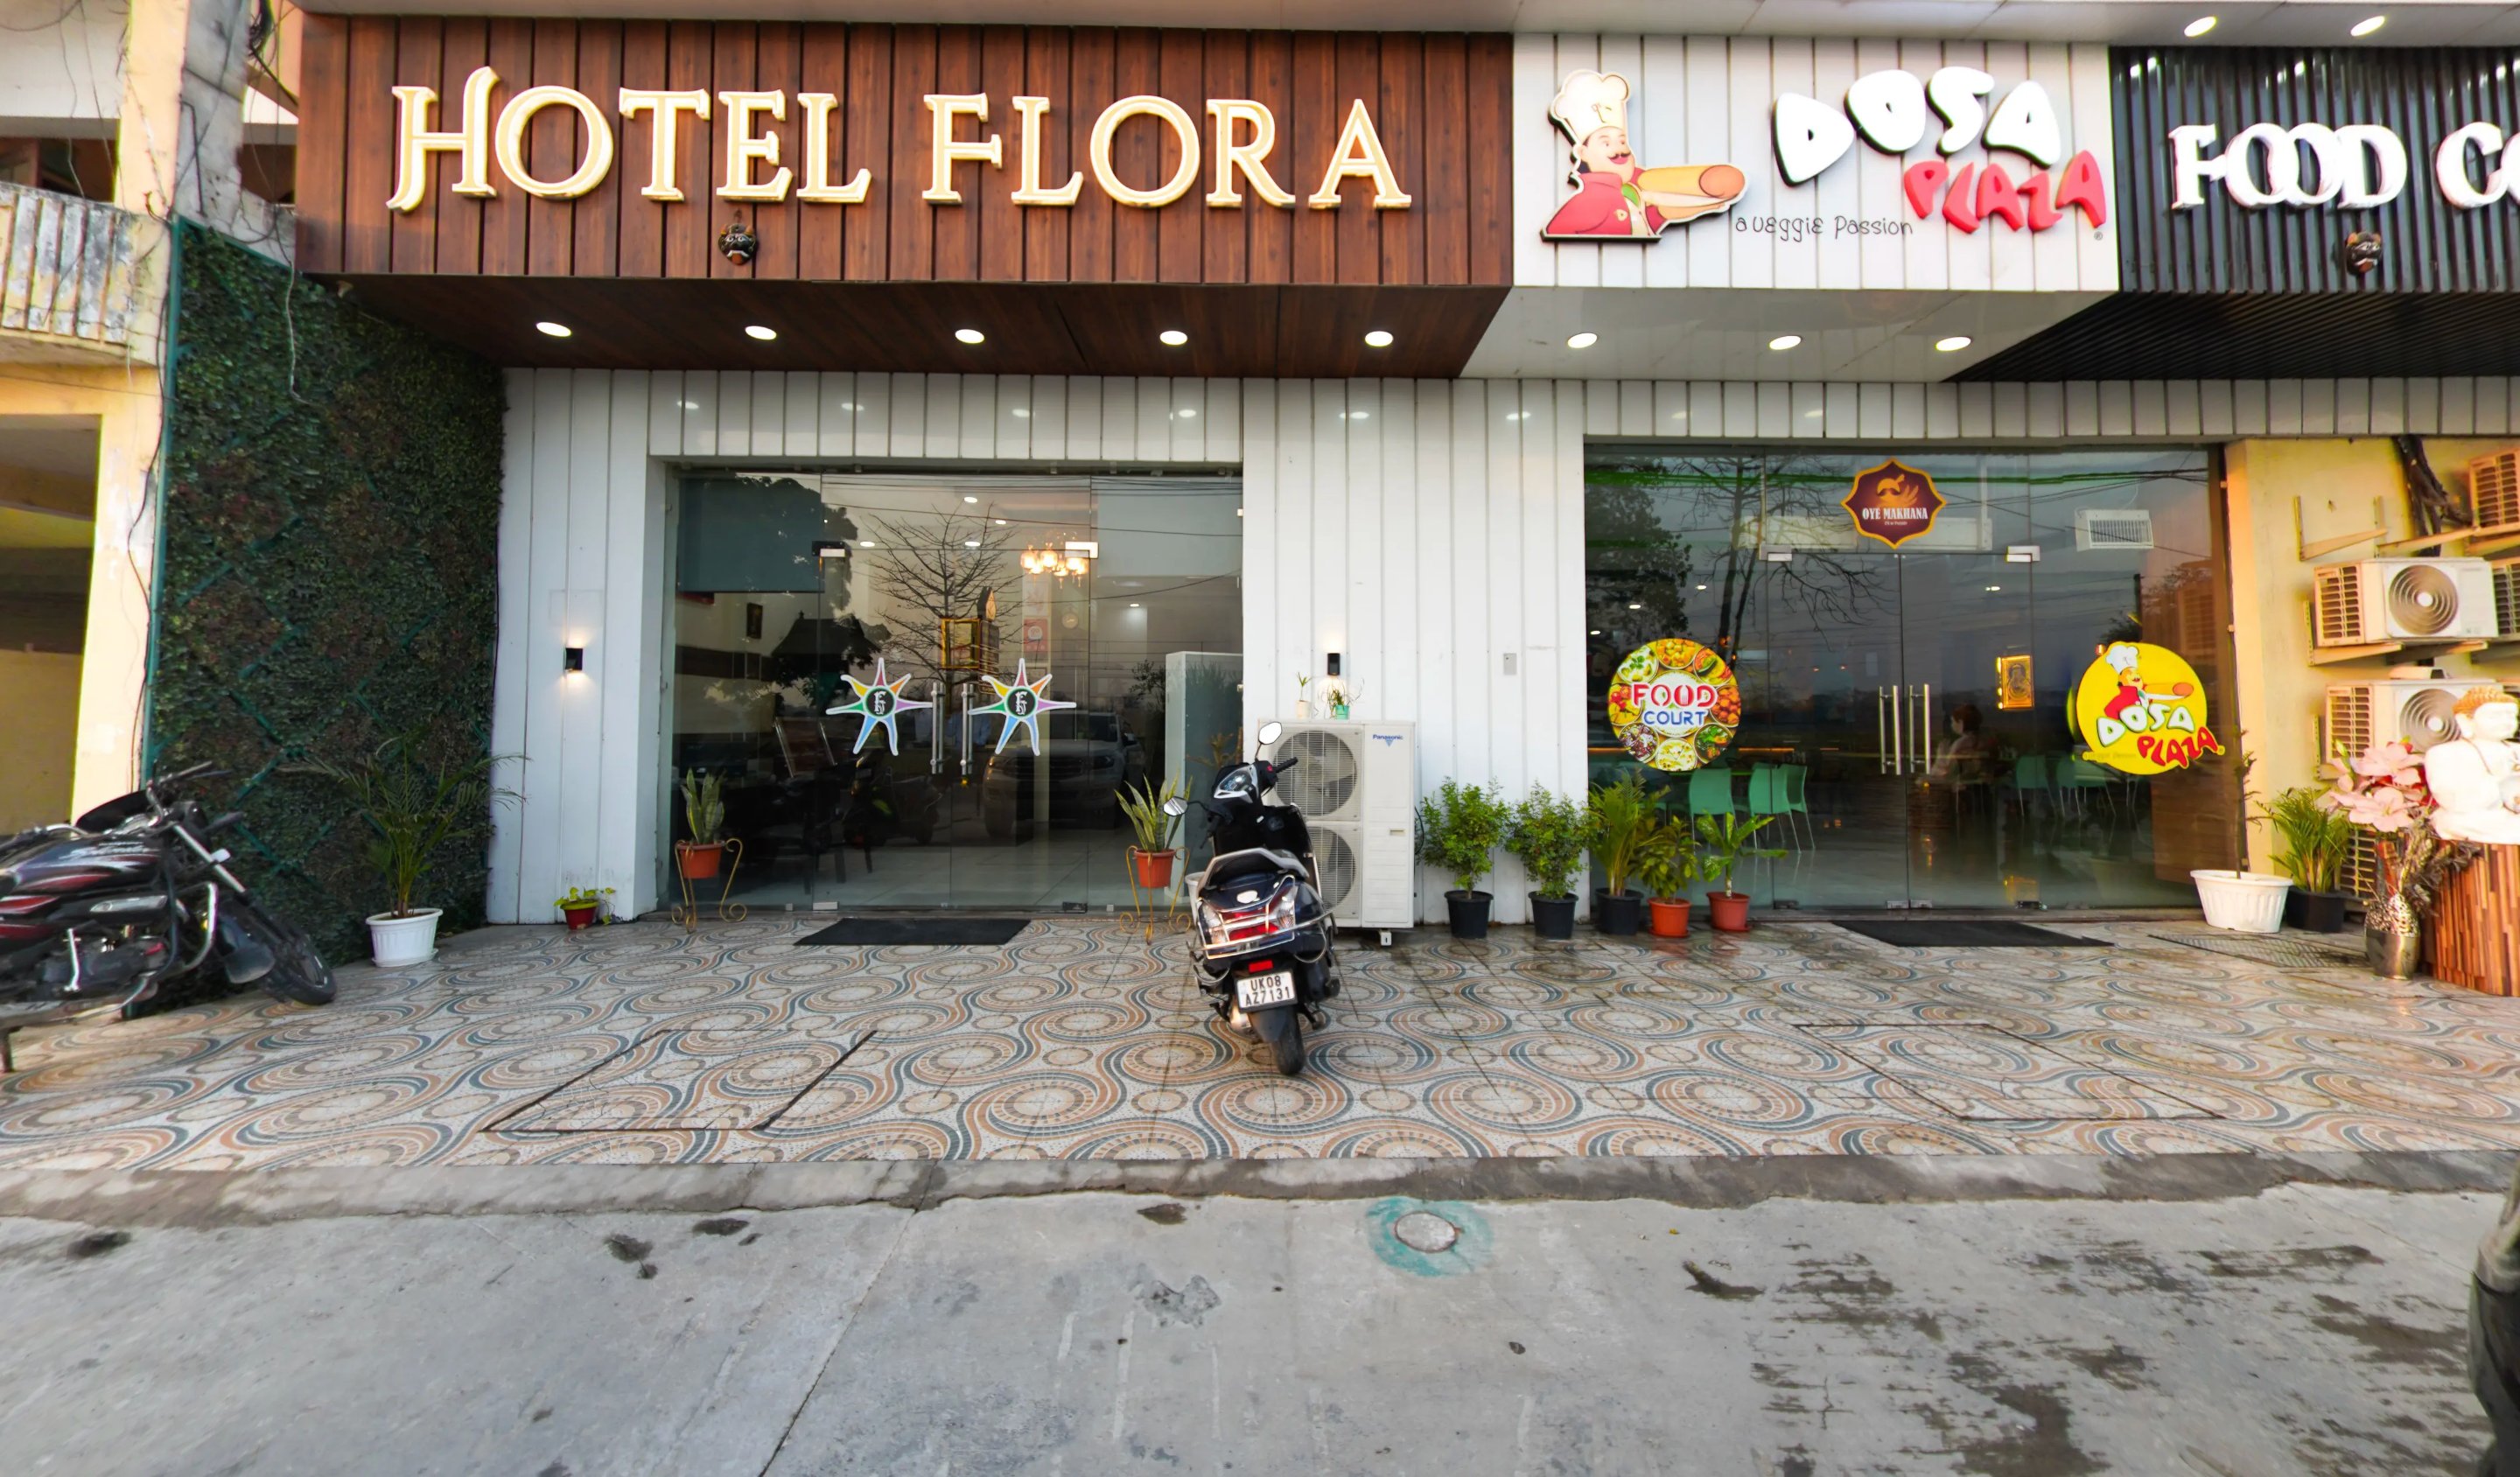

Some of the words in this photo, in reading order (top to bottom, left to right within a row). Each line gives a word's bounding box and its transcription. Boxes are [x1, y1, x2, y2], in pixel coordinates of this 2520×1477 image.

[386, 66, 872, 216] HOTEL
[922, 92, 1412, 210] FLORA
[1771, 66, 2062, 187] DOSA
[2168, 122, 2408, 210] FOOD
[2435, 121, 2520, 210] C
[1903, 149, 2107, 234] PLAZA
[1862, 508, 1881, 520] OYE
[1884, 508, 1928, 520] MAKHANA
[1633, 683, 1716, 708] FOOD
[1643, 710, 1706, 725] COURT
[2096, 703, 2195, 748] DOSA
[2136, 726, 2219, 768] PLAZA
[1245, 986, 1290, 1007] AZ7131
[1250, 975, 1282, 991] UK08
